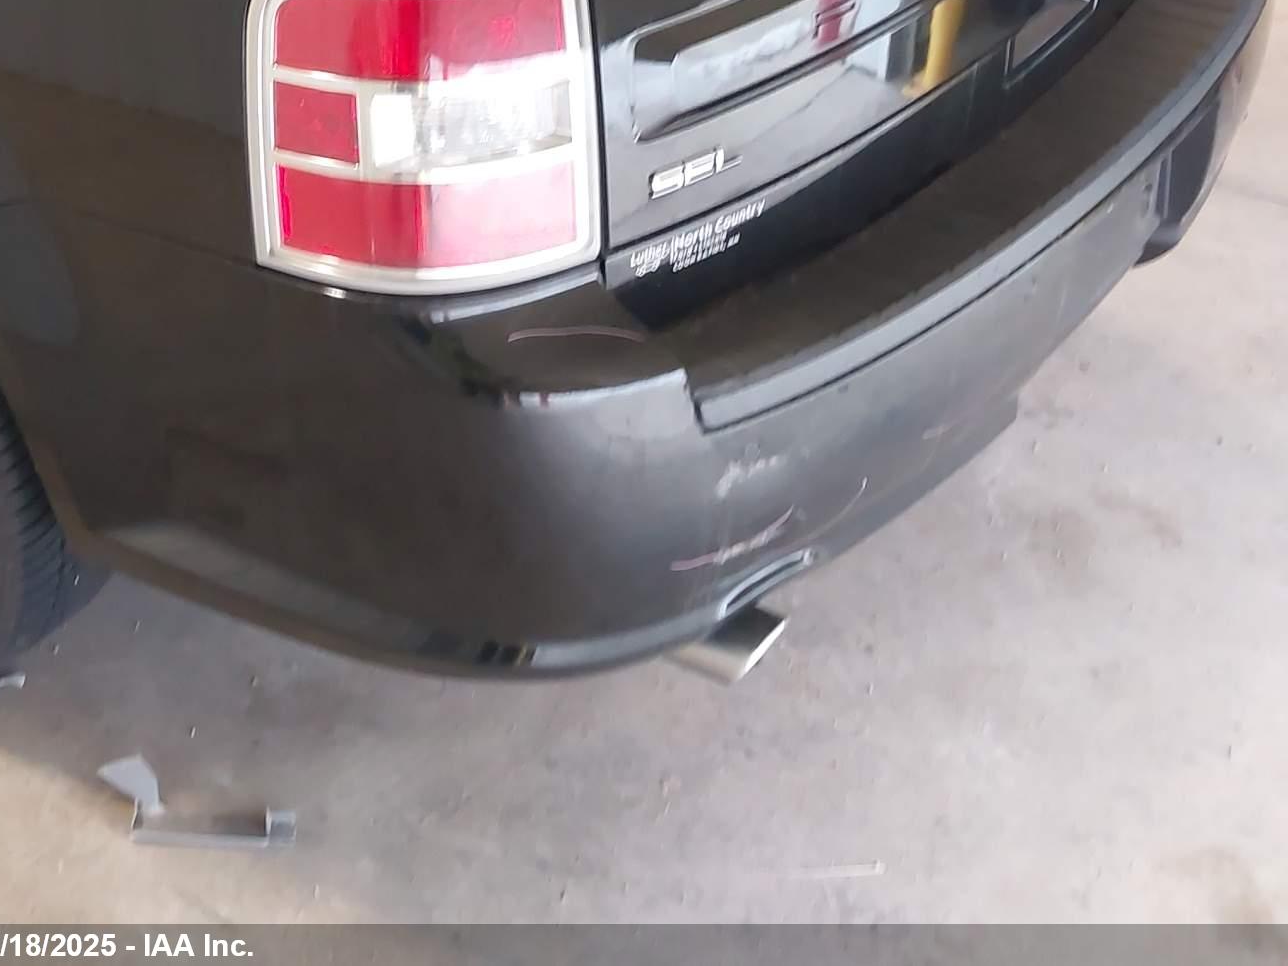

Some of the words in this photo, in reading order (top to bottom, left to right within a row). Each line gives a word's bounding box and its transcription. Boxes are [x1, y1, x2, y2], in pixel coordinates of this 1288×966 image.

[648, 146, 743, 200] SEL
[674, 221, 713, 251] North
[714, 198, 767, 234] Country
